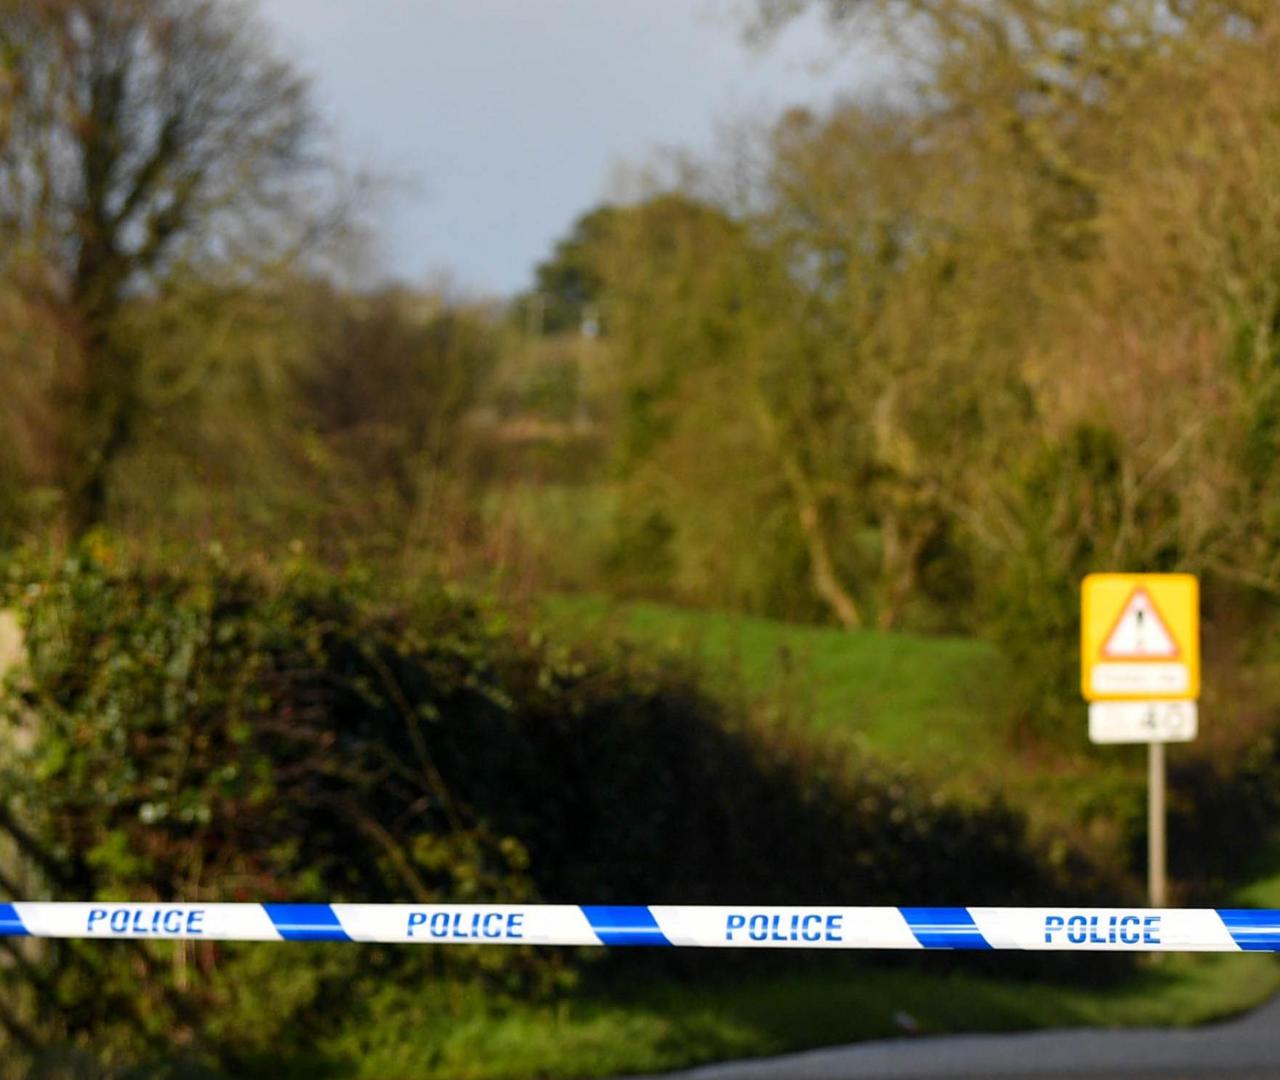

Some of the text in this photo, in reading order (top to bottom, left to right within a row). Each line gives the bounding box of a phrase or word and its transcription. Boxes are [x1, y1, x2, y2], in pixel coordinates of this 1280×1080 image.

[87, 909, 205, 935] POLICE
[407, 912, 523, 939] POLICE
[726, 914, 843, 942] POLICE
[1044, 915, 1160, 945] POLICE
